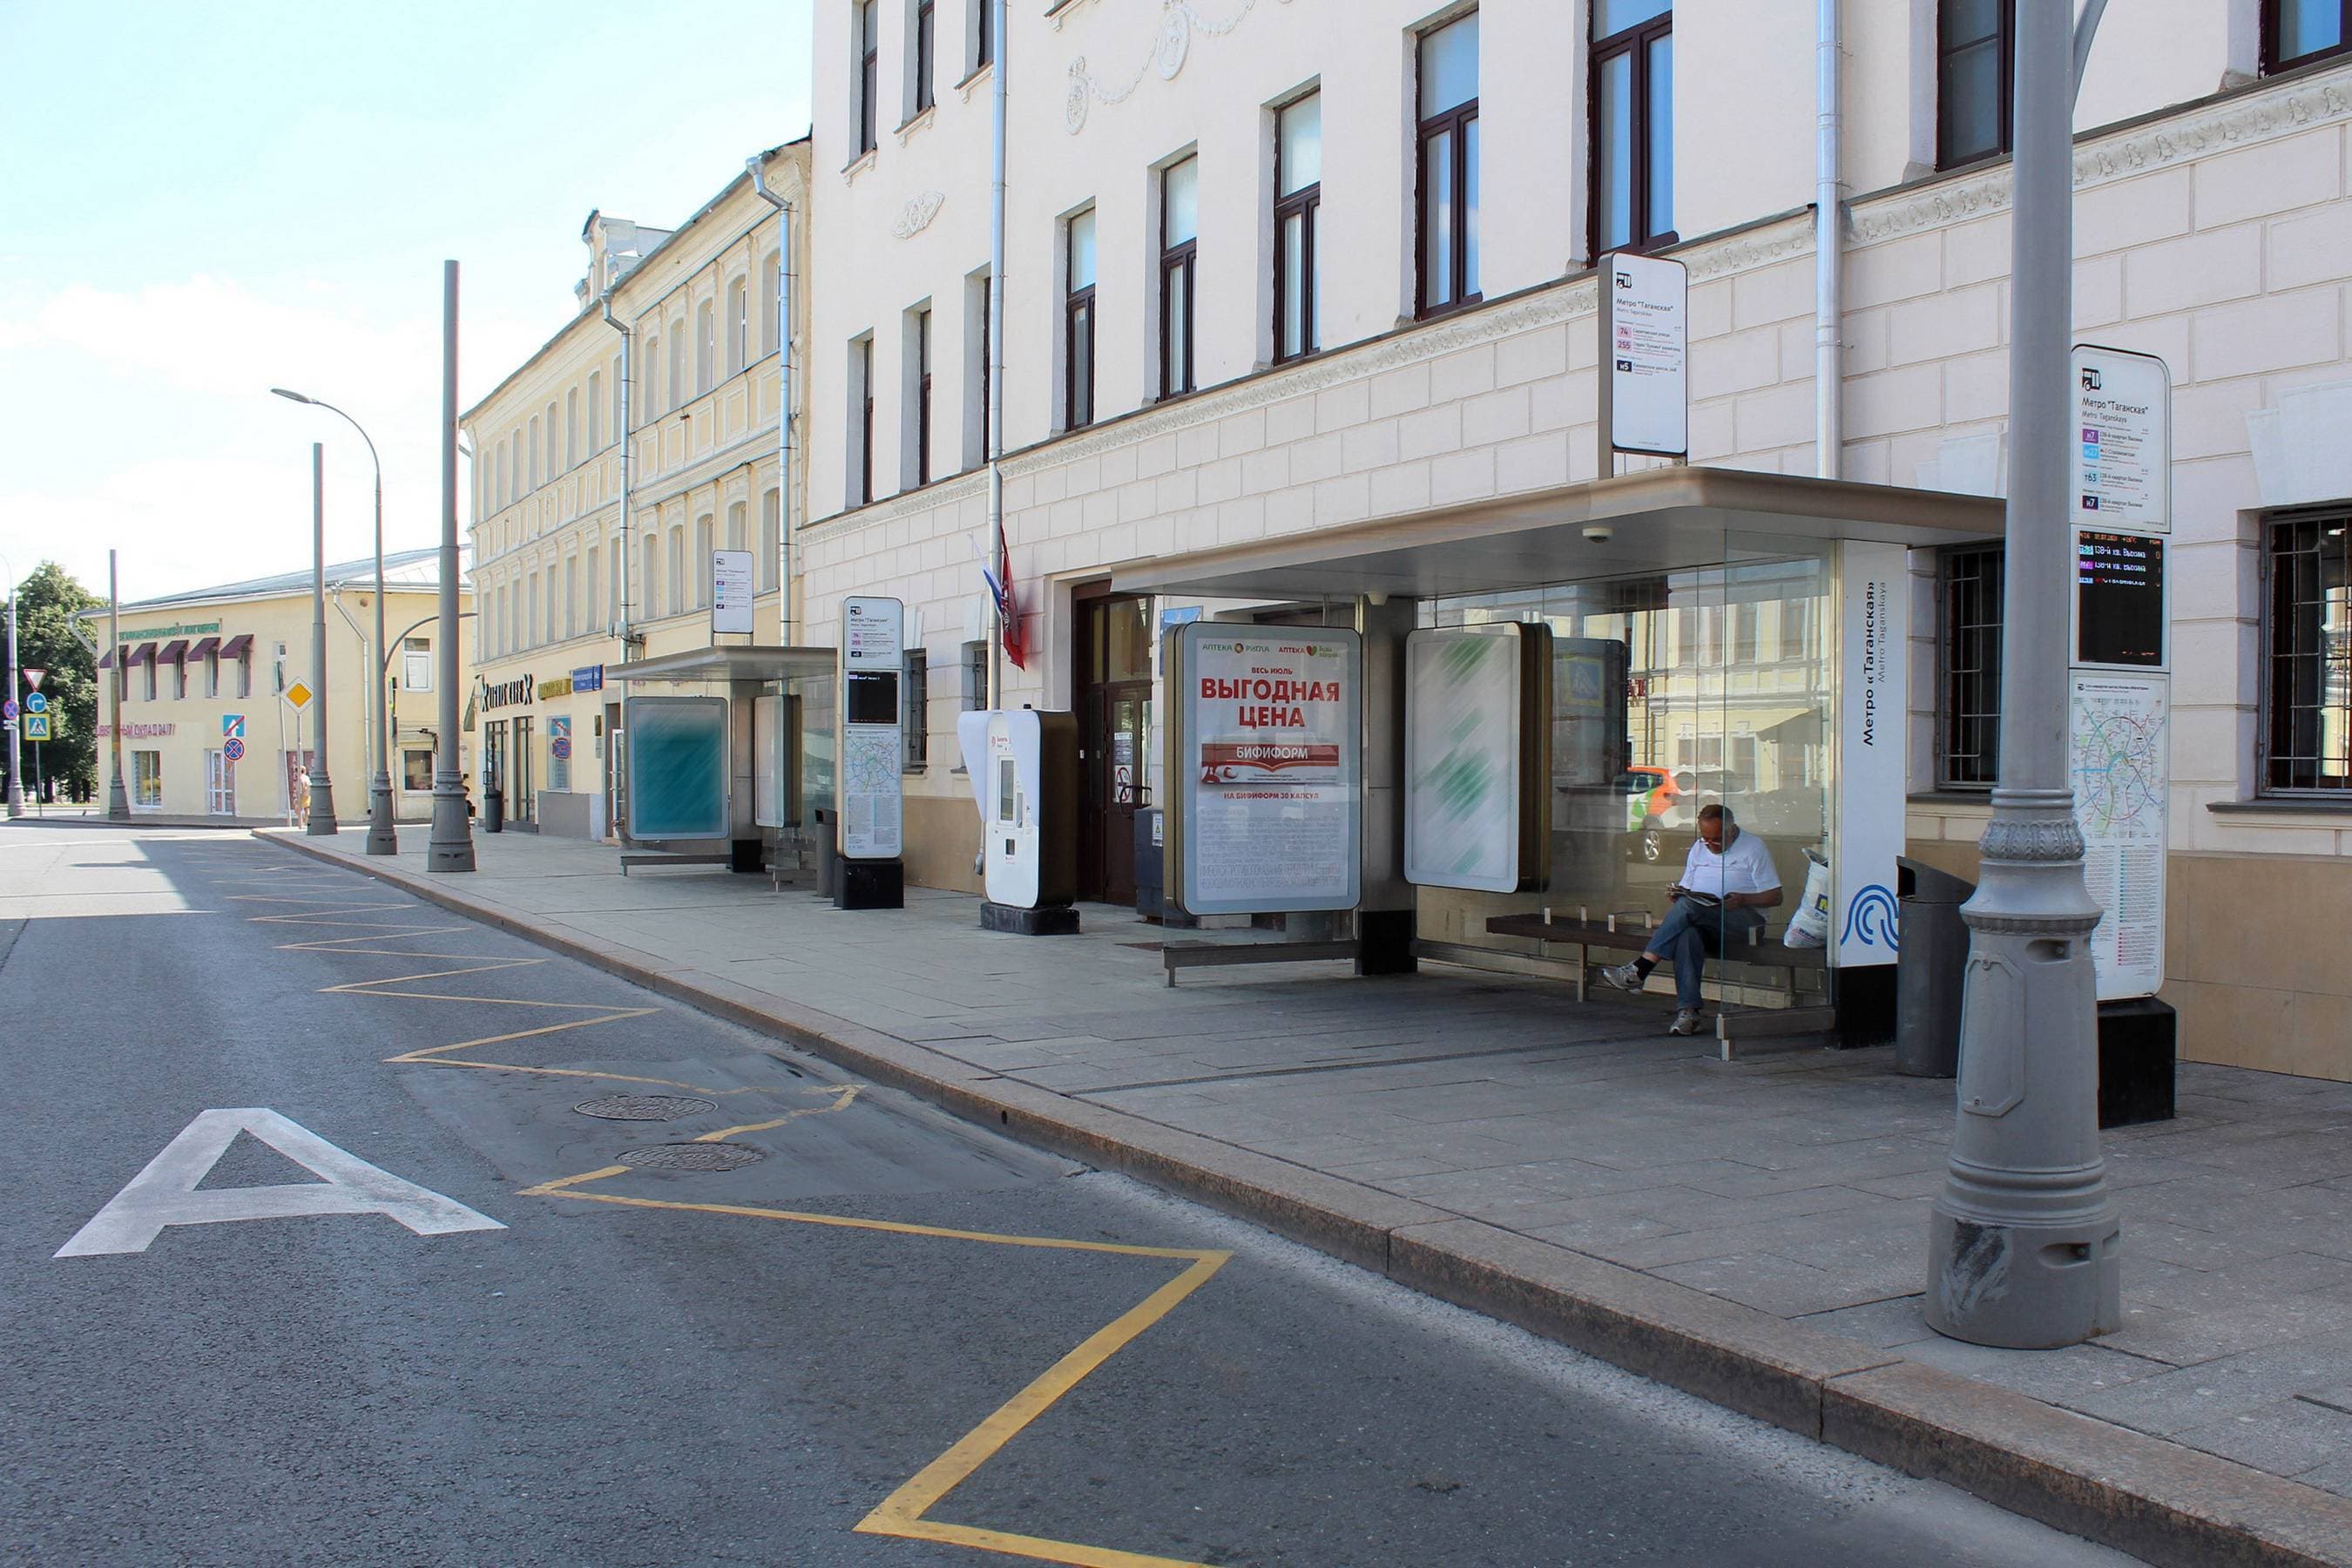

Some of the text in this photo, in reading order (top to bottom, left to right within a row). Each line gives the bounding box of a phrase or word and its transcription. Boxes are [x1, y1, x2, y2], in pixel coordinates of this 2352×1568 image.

[1617, 298, 1637, 307] Метро
[2082, 397, 2148, 414] Метро "Таганская"
[2085, 473, 2096, 482] т63
[1878, 582, 1886, 645] Taganskaya
[1201, 678, 1339, 704] ВЫГОДНАЯ
[1239, 706, 1305, 730] ЦЕНА
[1863, 689, 1876, 747] Метро
[1237, 745, 1308, 760] БИФИФОРМ
[53, 1107, 509, 1258] А
